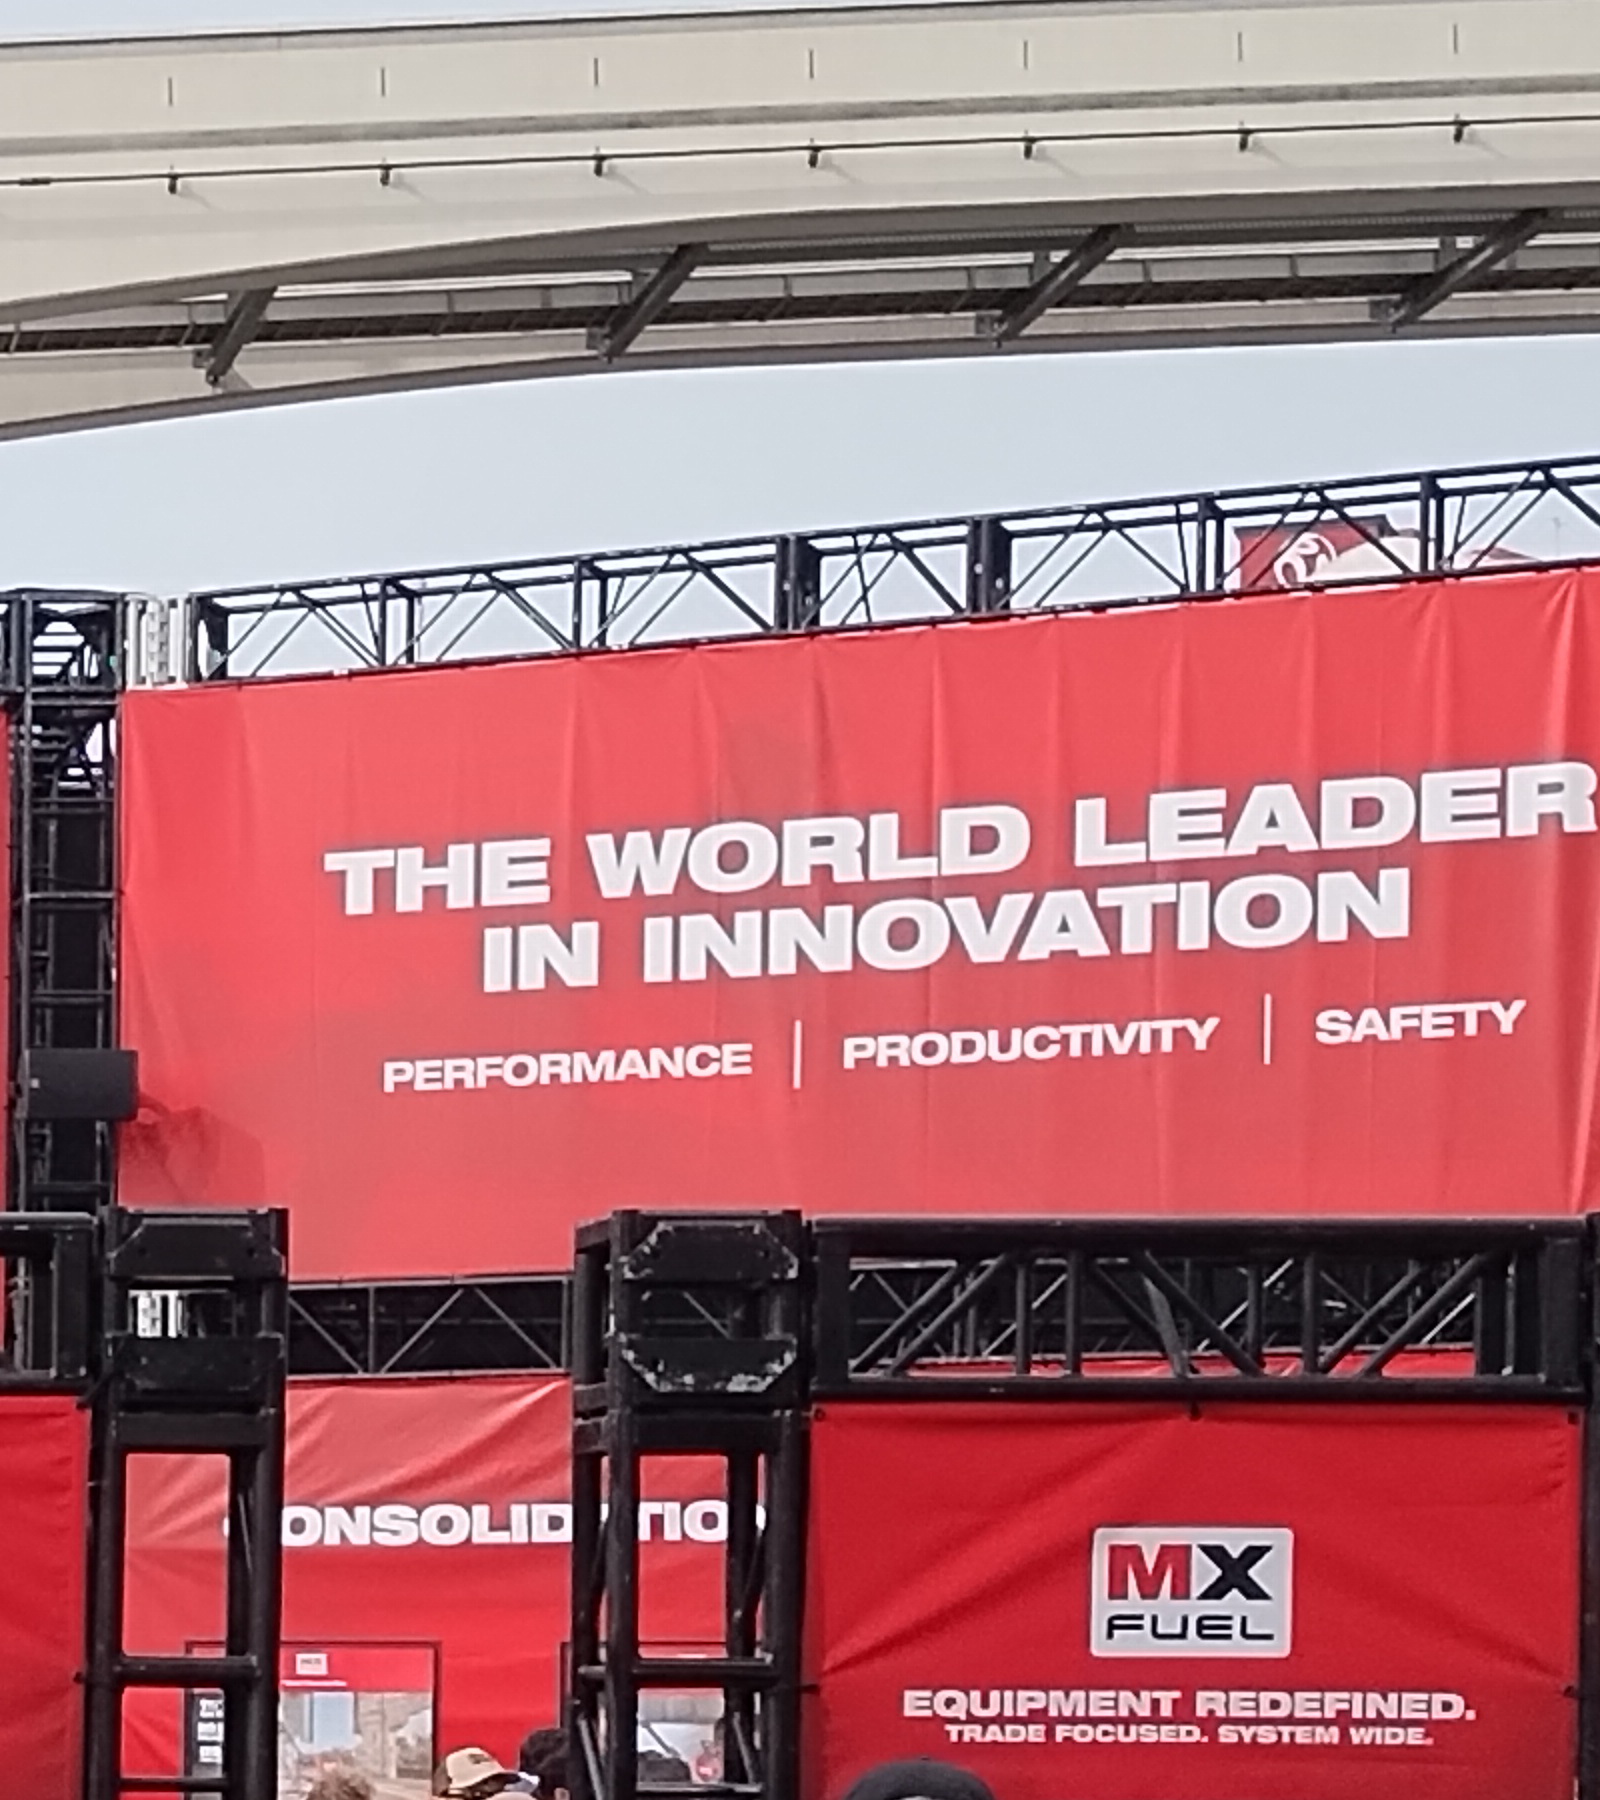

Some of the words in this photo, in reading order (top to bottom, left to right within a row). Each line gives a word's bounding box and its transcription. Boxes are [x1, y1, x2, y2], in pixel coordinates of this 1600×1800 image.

[325, 838, 551, 916] THE
[587, 804, 1032, 898] WORLD
[1075, 762, 1597, 866] LEADER
[484, 922, 598, 992] IN
[642, 867, 1410, 984] INNOVATION
[384, 1044, 752, 1092] PERFORMANCE
[844, 1018, 1219, 1068] PRODUCTIVITY
[1316, 1000, 1526, 1044] SAFETY
[224, 1500, 766, 1547] ONSOLIDTIO
[1107, 1544, 1272, 1600] MX
[1106, 1614, 1274, 1641] FUEL
[904, 1690, 1181, 1720] EQUIPMENT
[1196, 1691, 1475, 1720] REDEFINED.
[945, 1724, 1046, 1742] TRADE
[1056, 1724, 1208, 1742] FOCUSED.
[1218, 1725, 1339, 1744] SYSTEM
[1350, 1727, 1432, 1744] WIDE.
